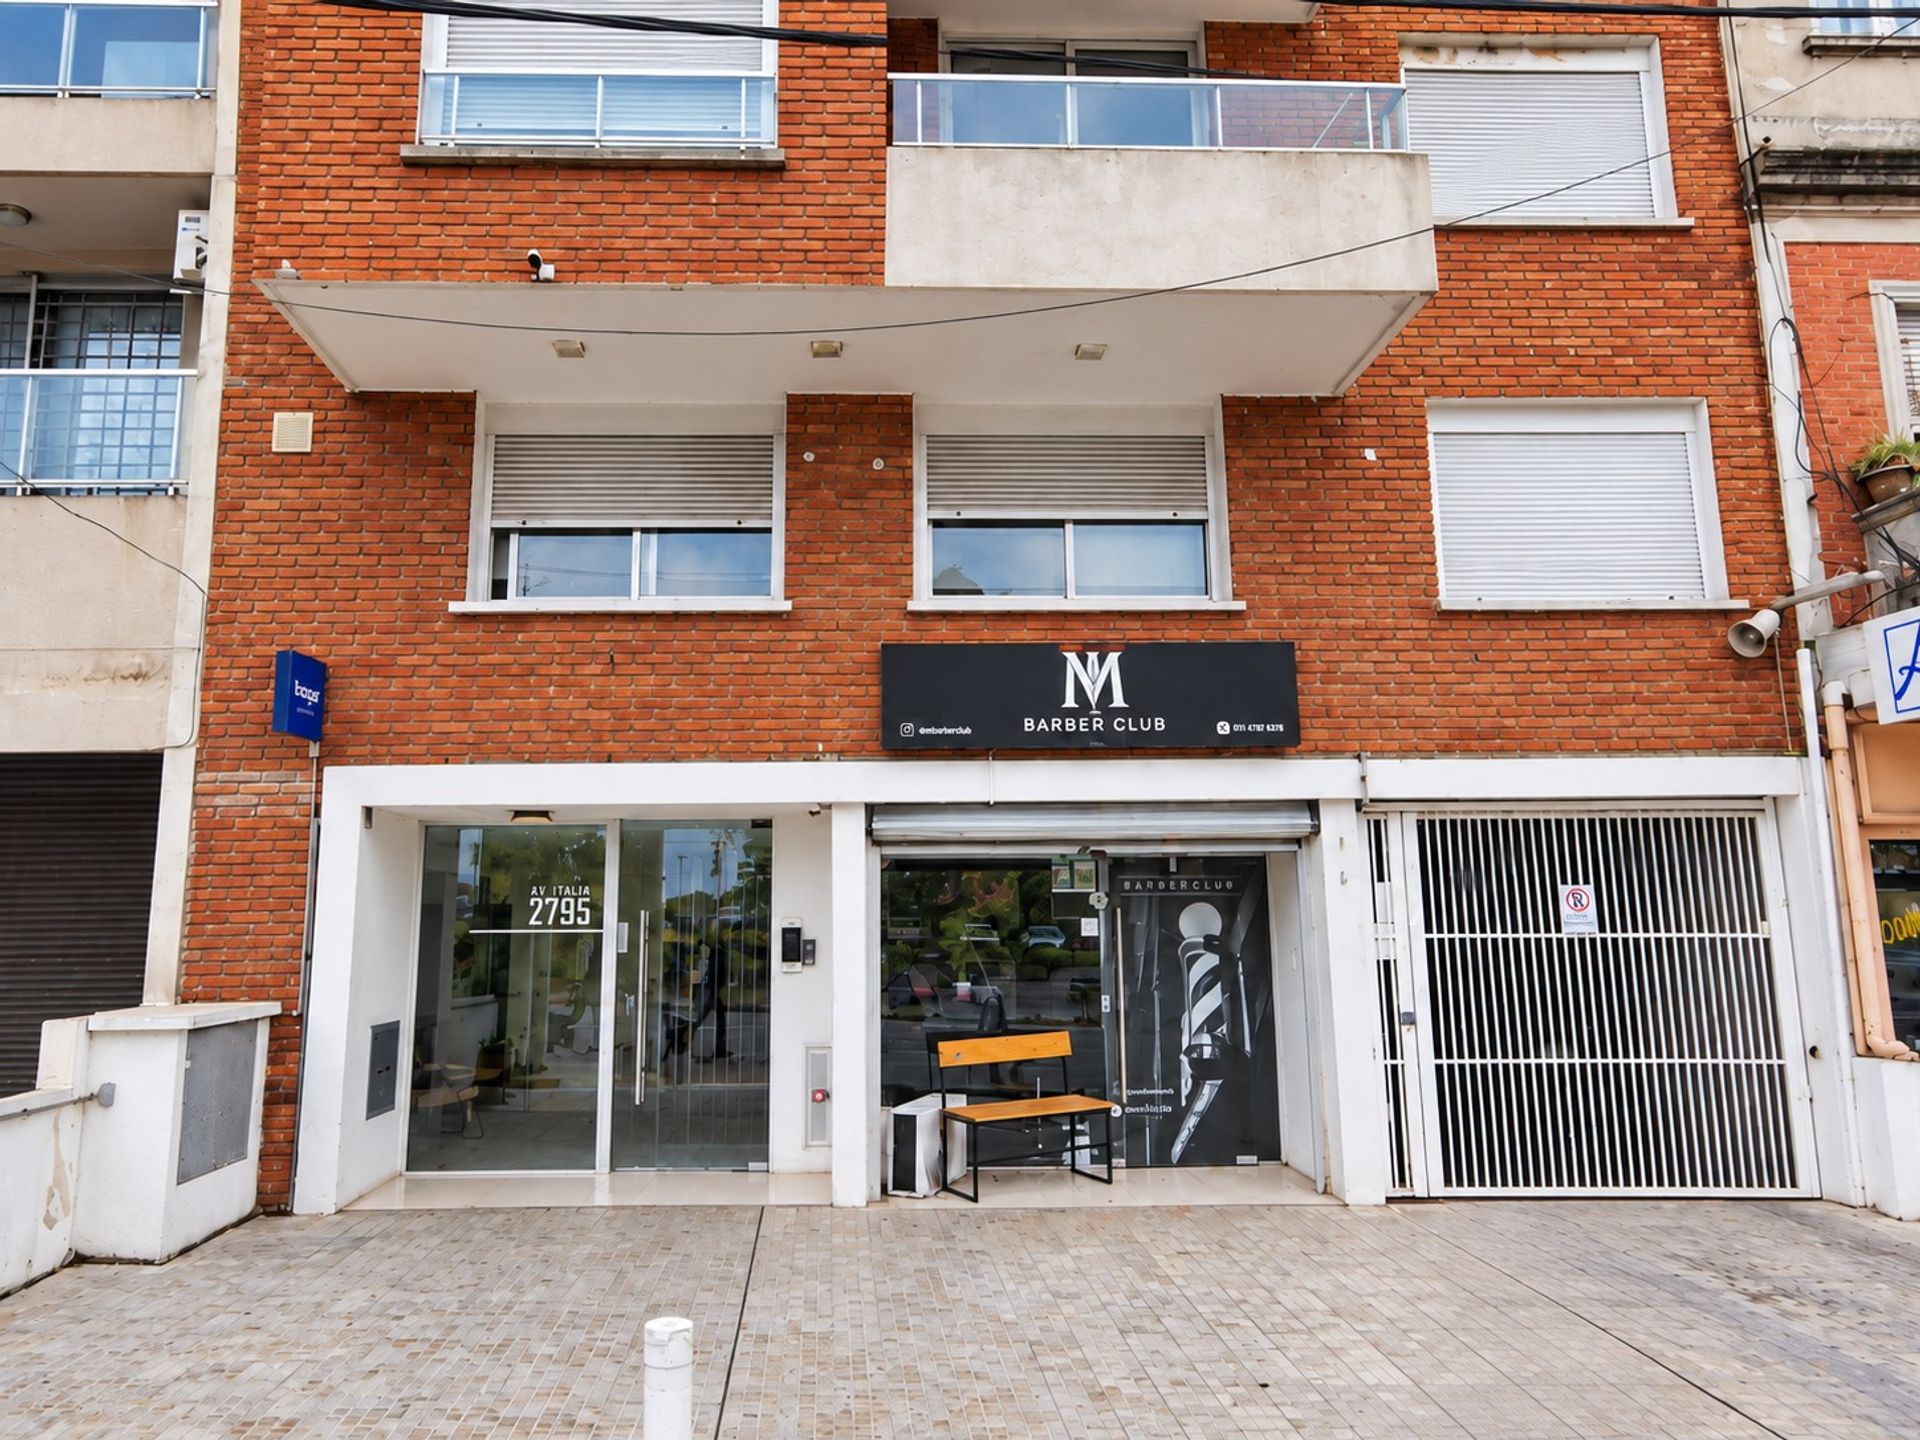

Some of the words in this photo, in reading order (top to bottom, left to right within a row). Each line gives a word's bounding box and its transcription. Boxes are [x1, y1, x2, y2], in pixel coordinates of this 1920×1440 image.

[1023, 717, 1105, 732] BARBER
[1113, 717, 1166, 732] CLUB
[530, 885, 546, 896] AV
[552, 885, 591, 896] ITALIA
[528, 897, 591, 926] 2795
